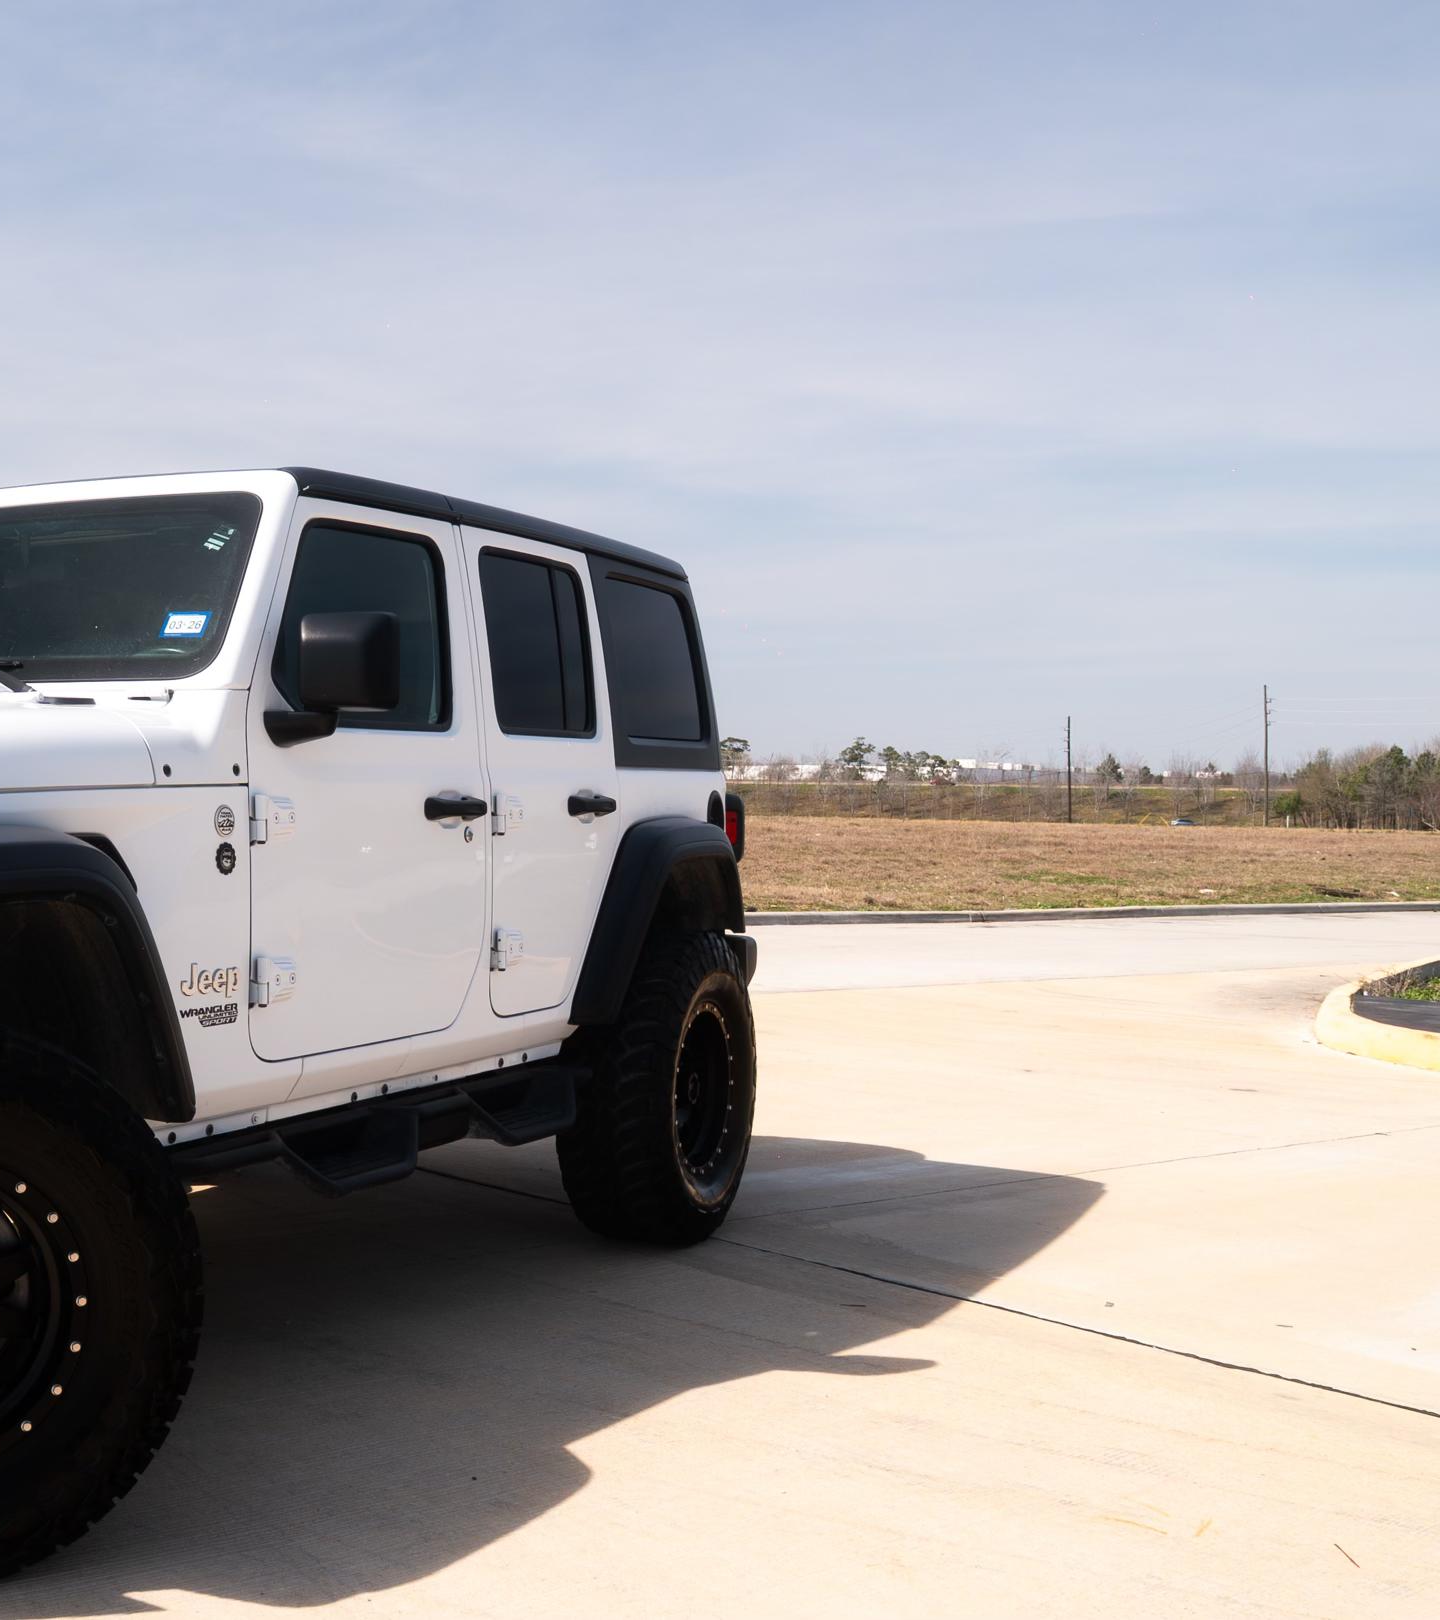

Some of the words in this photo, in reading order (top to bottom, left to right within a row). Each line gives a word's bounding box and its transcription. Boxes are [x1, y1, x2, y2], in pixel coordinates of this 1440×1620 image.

[180, 962, 239, 998] Jeep
[179, 1003, 238, 1019] WRANGLER
[201, 1017, 236, 1027] SPORT
